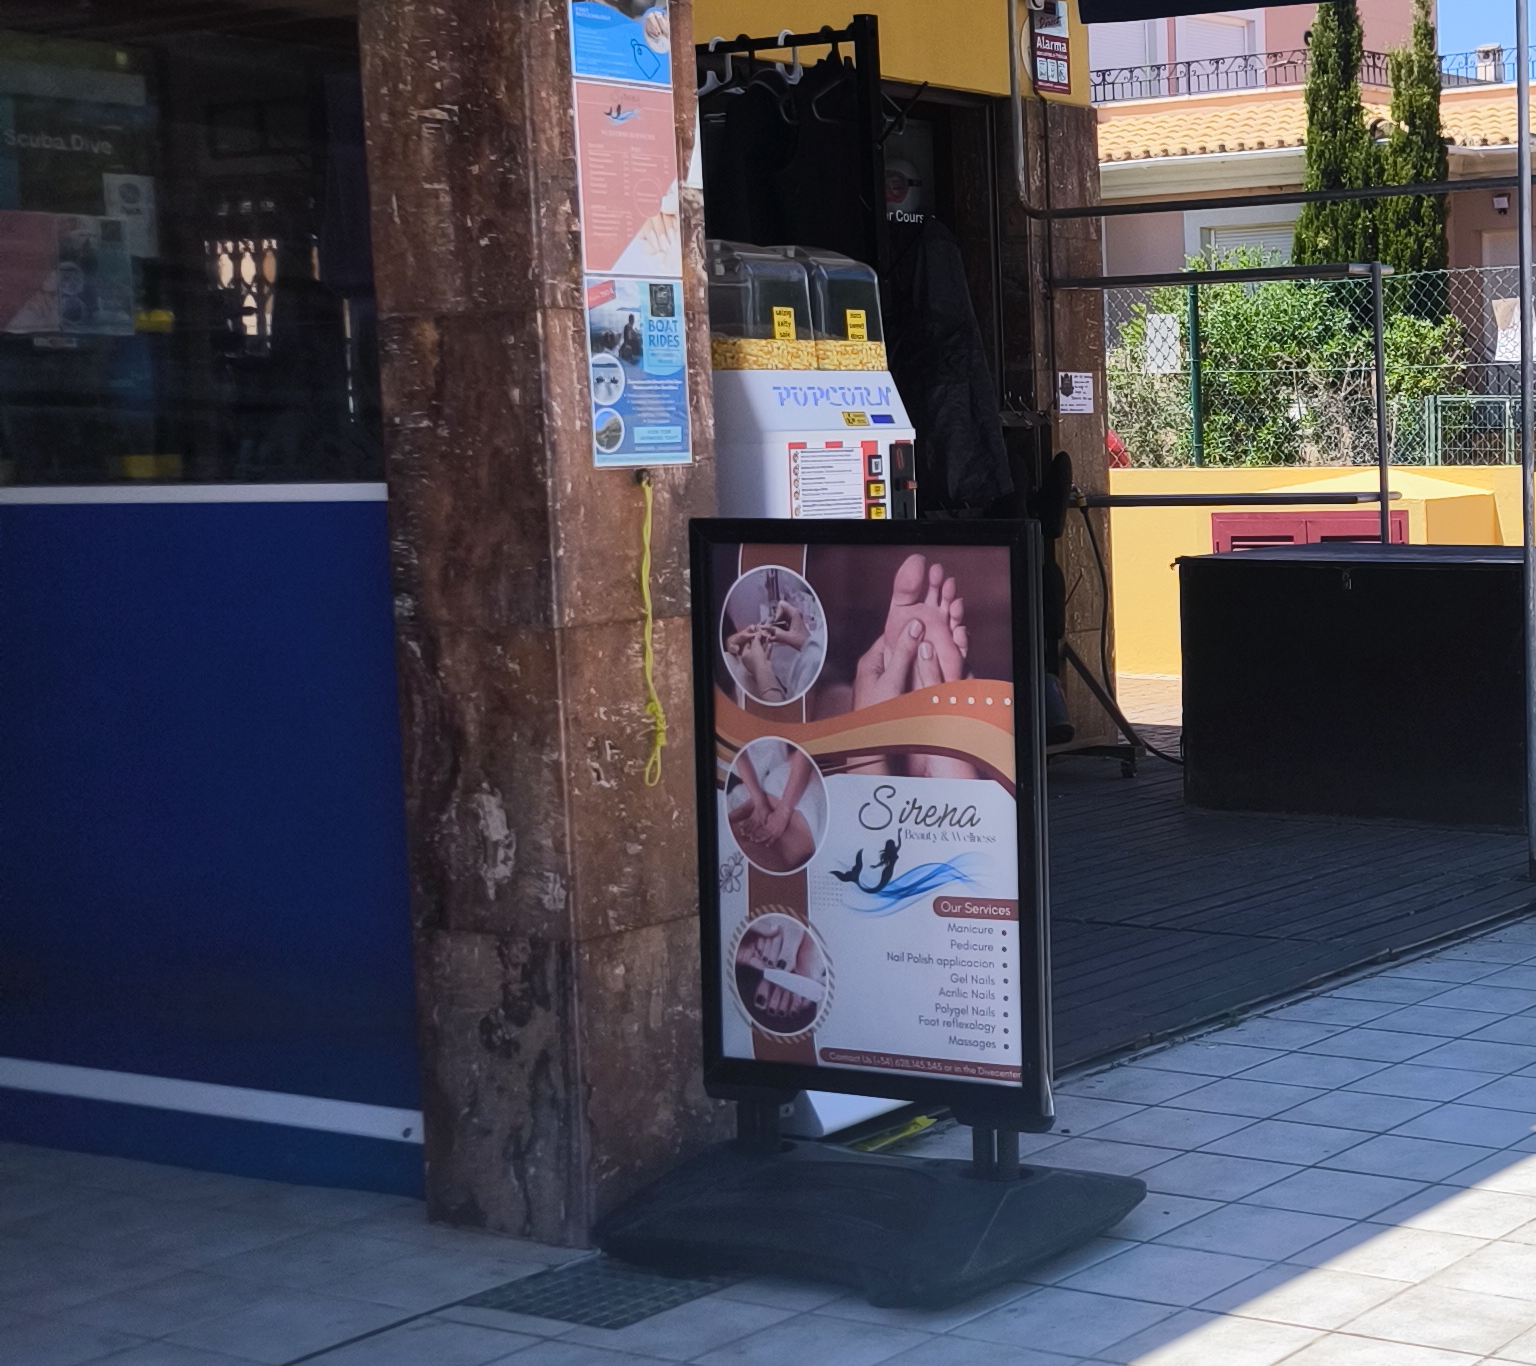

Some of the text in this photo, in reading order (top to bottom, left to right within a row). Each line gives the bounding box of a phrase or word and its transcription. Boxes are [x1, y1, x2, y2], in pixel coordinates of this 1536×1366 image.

[1037, 36, 1068, 53] Alarma
[70, 134, 113, 155] Dive
[648, 319, 678, 333] BOAT
[648, 334, 680, 348] RIDES
[772, 385, 892, 407] POPCORN
[858, 784, 982, 831] Sirena
[904, 828, 937, 843] Beauty
[941, 830, 949, 842] &
[941, 900, 1011, 916] Our Services
[947, 923, 994, 935] Manicure
[950, 939, 994, 951] Pedicure
[886, 951, 995, 969] Nail Polish applicacion
[950, 973, 996, 986] Gel Nails
[971, 989, 996, 1000] Nails
[935, 1003, 996, 1018] Polygel Nails
[918, 1015, 996, 1034] Foot reflexology
[948, 1035, 997, 1050] Massages
[829, 1051, 862, 1063] Contact
[862, 1054, 872, 1064] Us
[954, 1064, 962, 1073] in
[963, 1064, 976, 1074] the
[978, 1066, 1022, 1079] Divecenter
